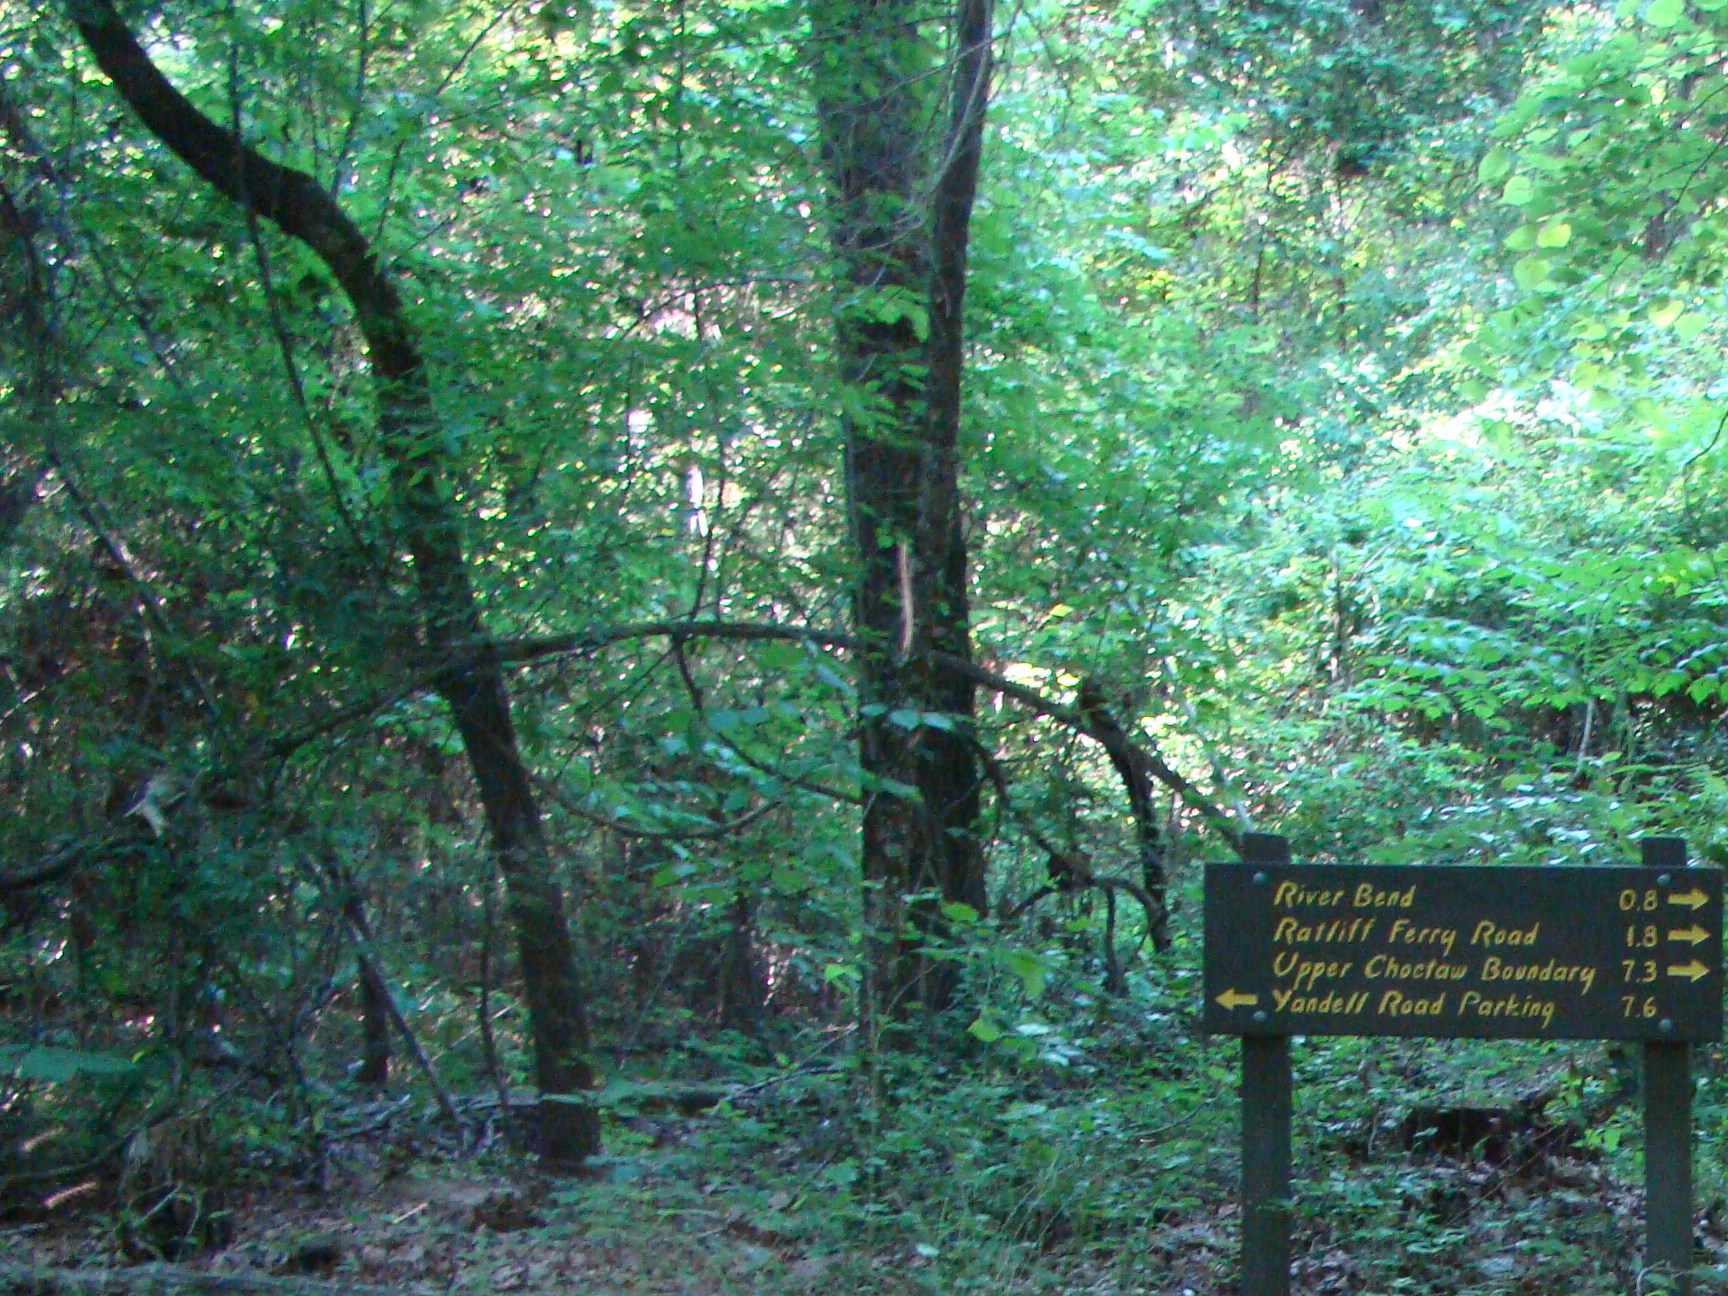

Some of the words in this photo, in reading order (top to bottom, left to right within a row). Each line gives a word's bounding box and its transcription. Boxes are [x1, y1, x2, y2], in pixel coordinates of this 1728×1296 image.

[1272, 881, 1344, 908] River
[1353, 882, 1416, 909] Bend
[1619, 888, 1658, 911] 0.8
[1272, 916, 1374, 946] Ratliff
[1388, 919, 1456, 956] Ferry
[1471, 920, 1539, 947] Road
[1626, 926, 1658, 948] 1.8
[1272, 954, 1352, 991] Upper
[1364, 953, 1467, 982] Choctaw
[1481, 957, 1597, 995] Boundary
[1622, 961, 1658, 983] 7.3
[1271, 988, 1367, 1014] Yandell
[1377, 990, 1445, 1016] Road
[1458, 990, 1556, 1029] Parking
[1622, 996, 1657, 1018] 7.6
